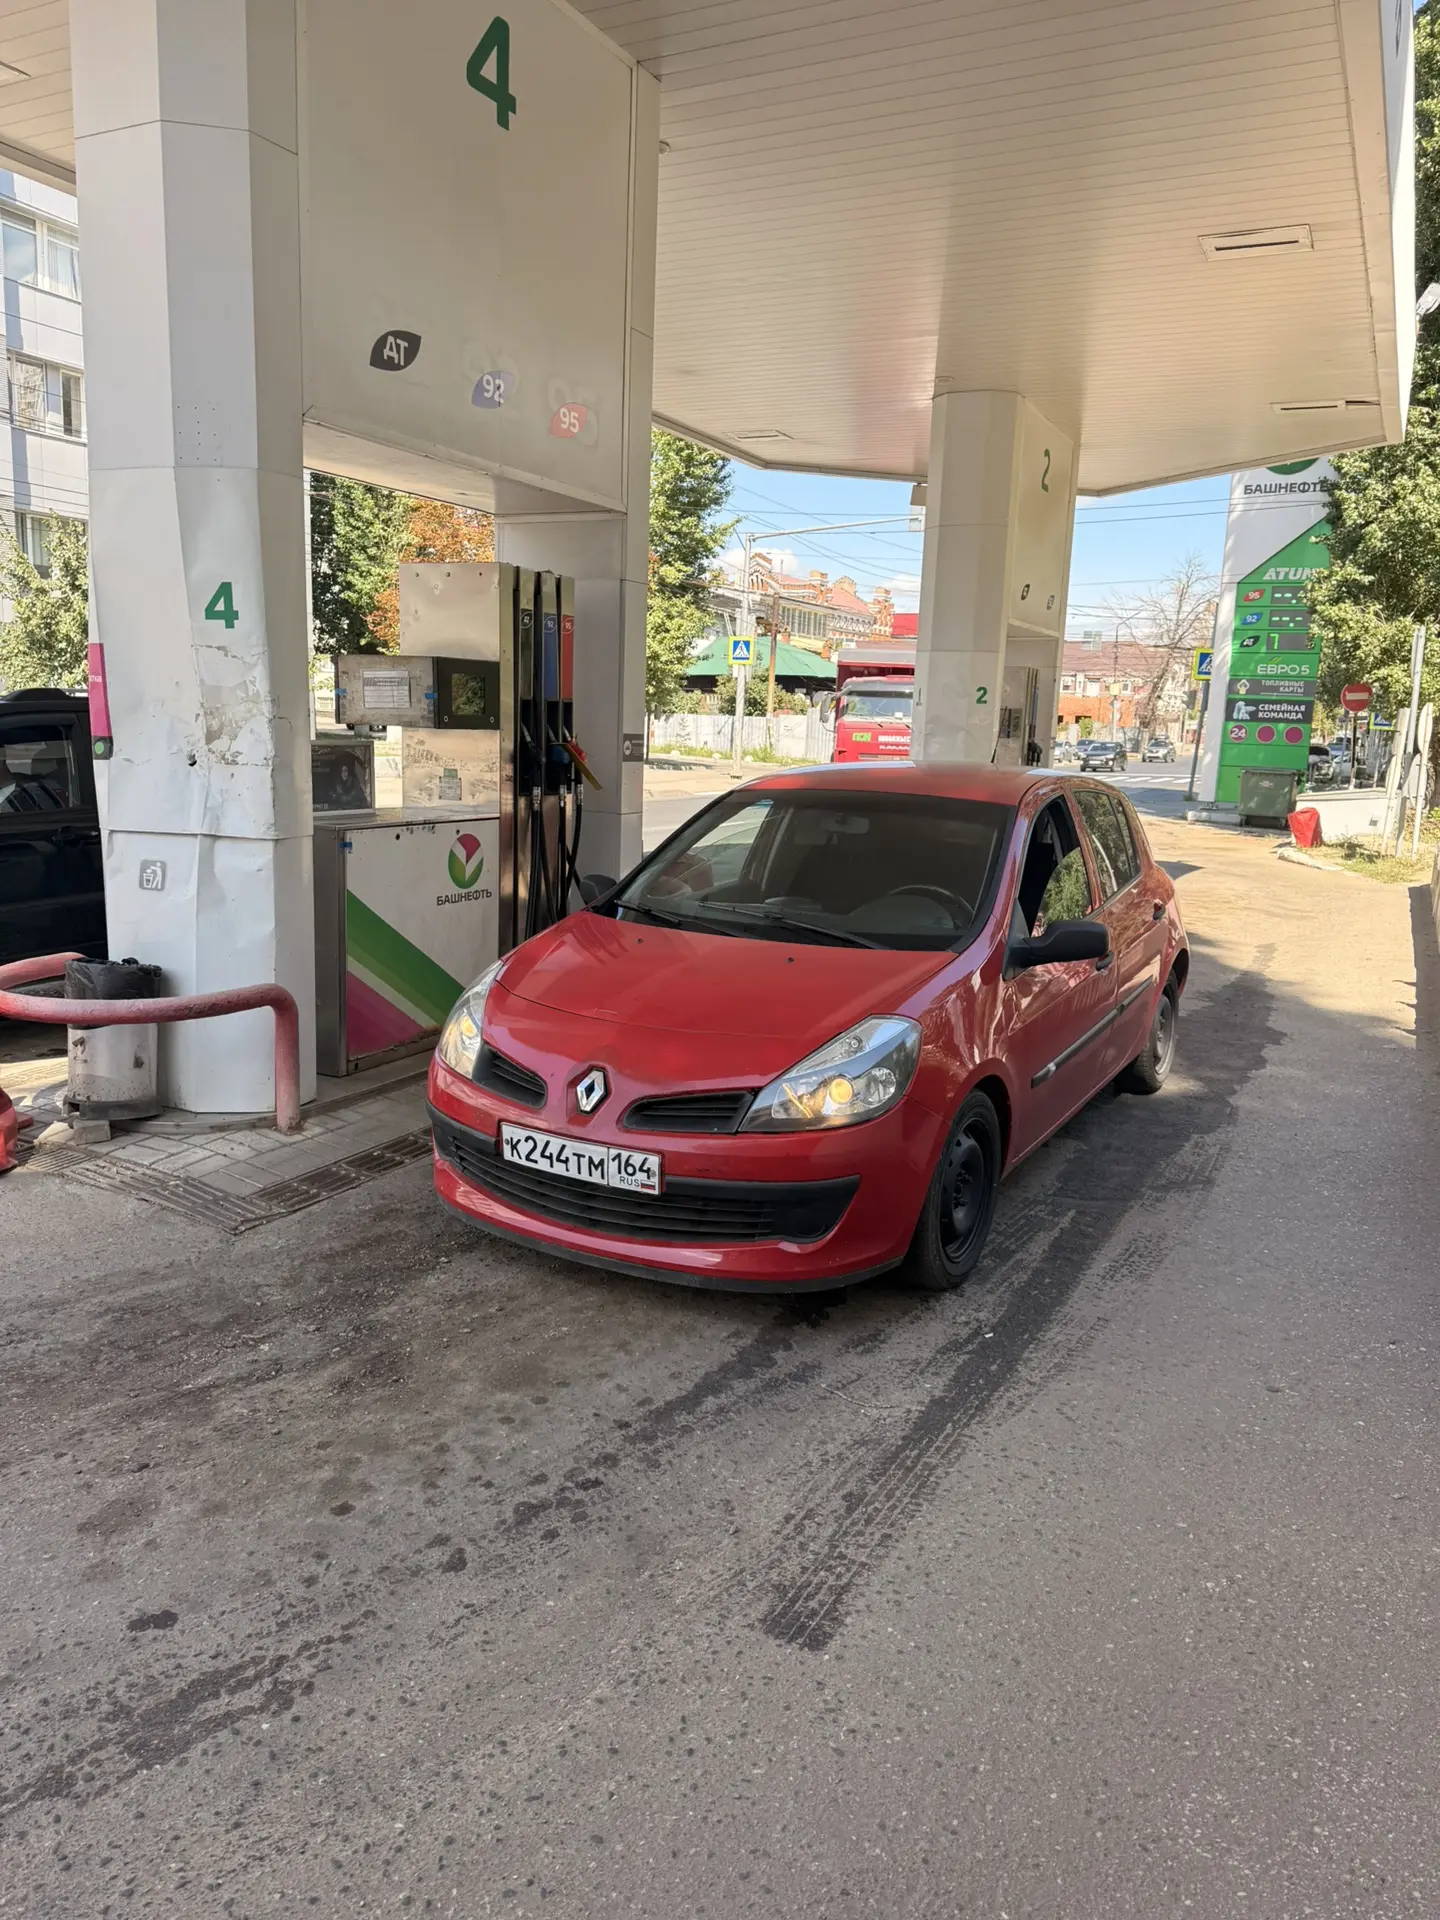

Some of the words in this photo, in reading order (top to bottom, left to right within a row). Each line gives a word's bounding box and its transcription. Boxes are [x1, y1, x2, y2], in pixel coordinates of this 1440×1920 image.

[467, 16, 517, 131] 4
[482, 373, 505, 404] 92
[559, 407, 580, 433] 95
[1248, 591, 1261, 599] 95
[204, 581, 239, 629] 4
[1246, 615, 1258, 623] 92
[976, 686, 988, 705] 2
[1258, 703, 1306, 712] СЕМЕЙНАЯ
[1258, 712, 1303, 720] КОМАНДА
[1230, 728, 1246, 738] 24
[436, 888, 492, 906] БАШНЕФТЬ
[510, 1135, 605, 1180] К244ТМ
[611, 1152, 651, 1180] 164
[619, 1176, 640, 1188] RUS
